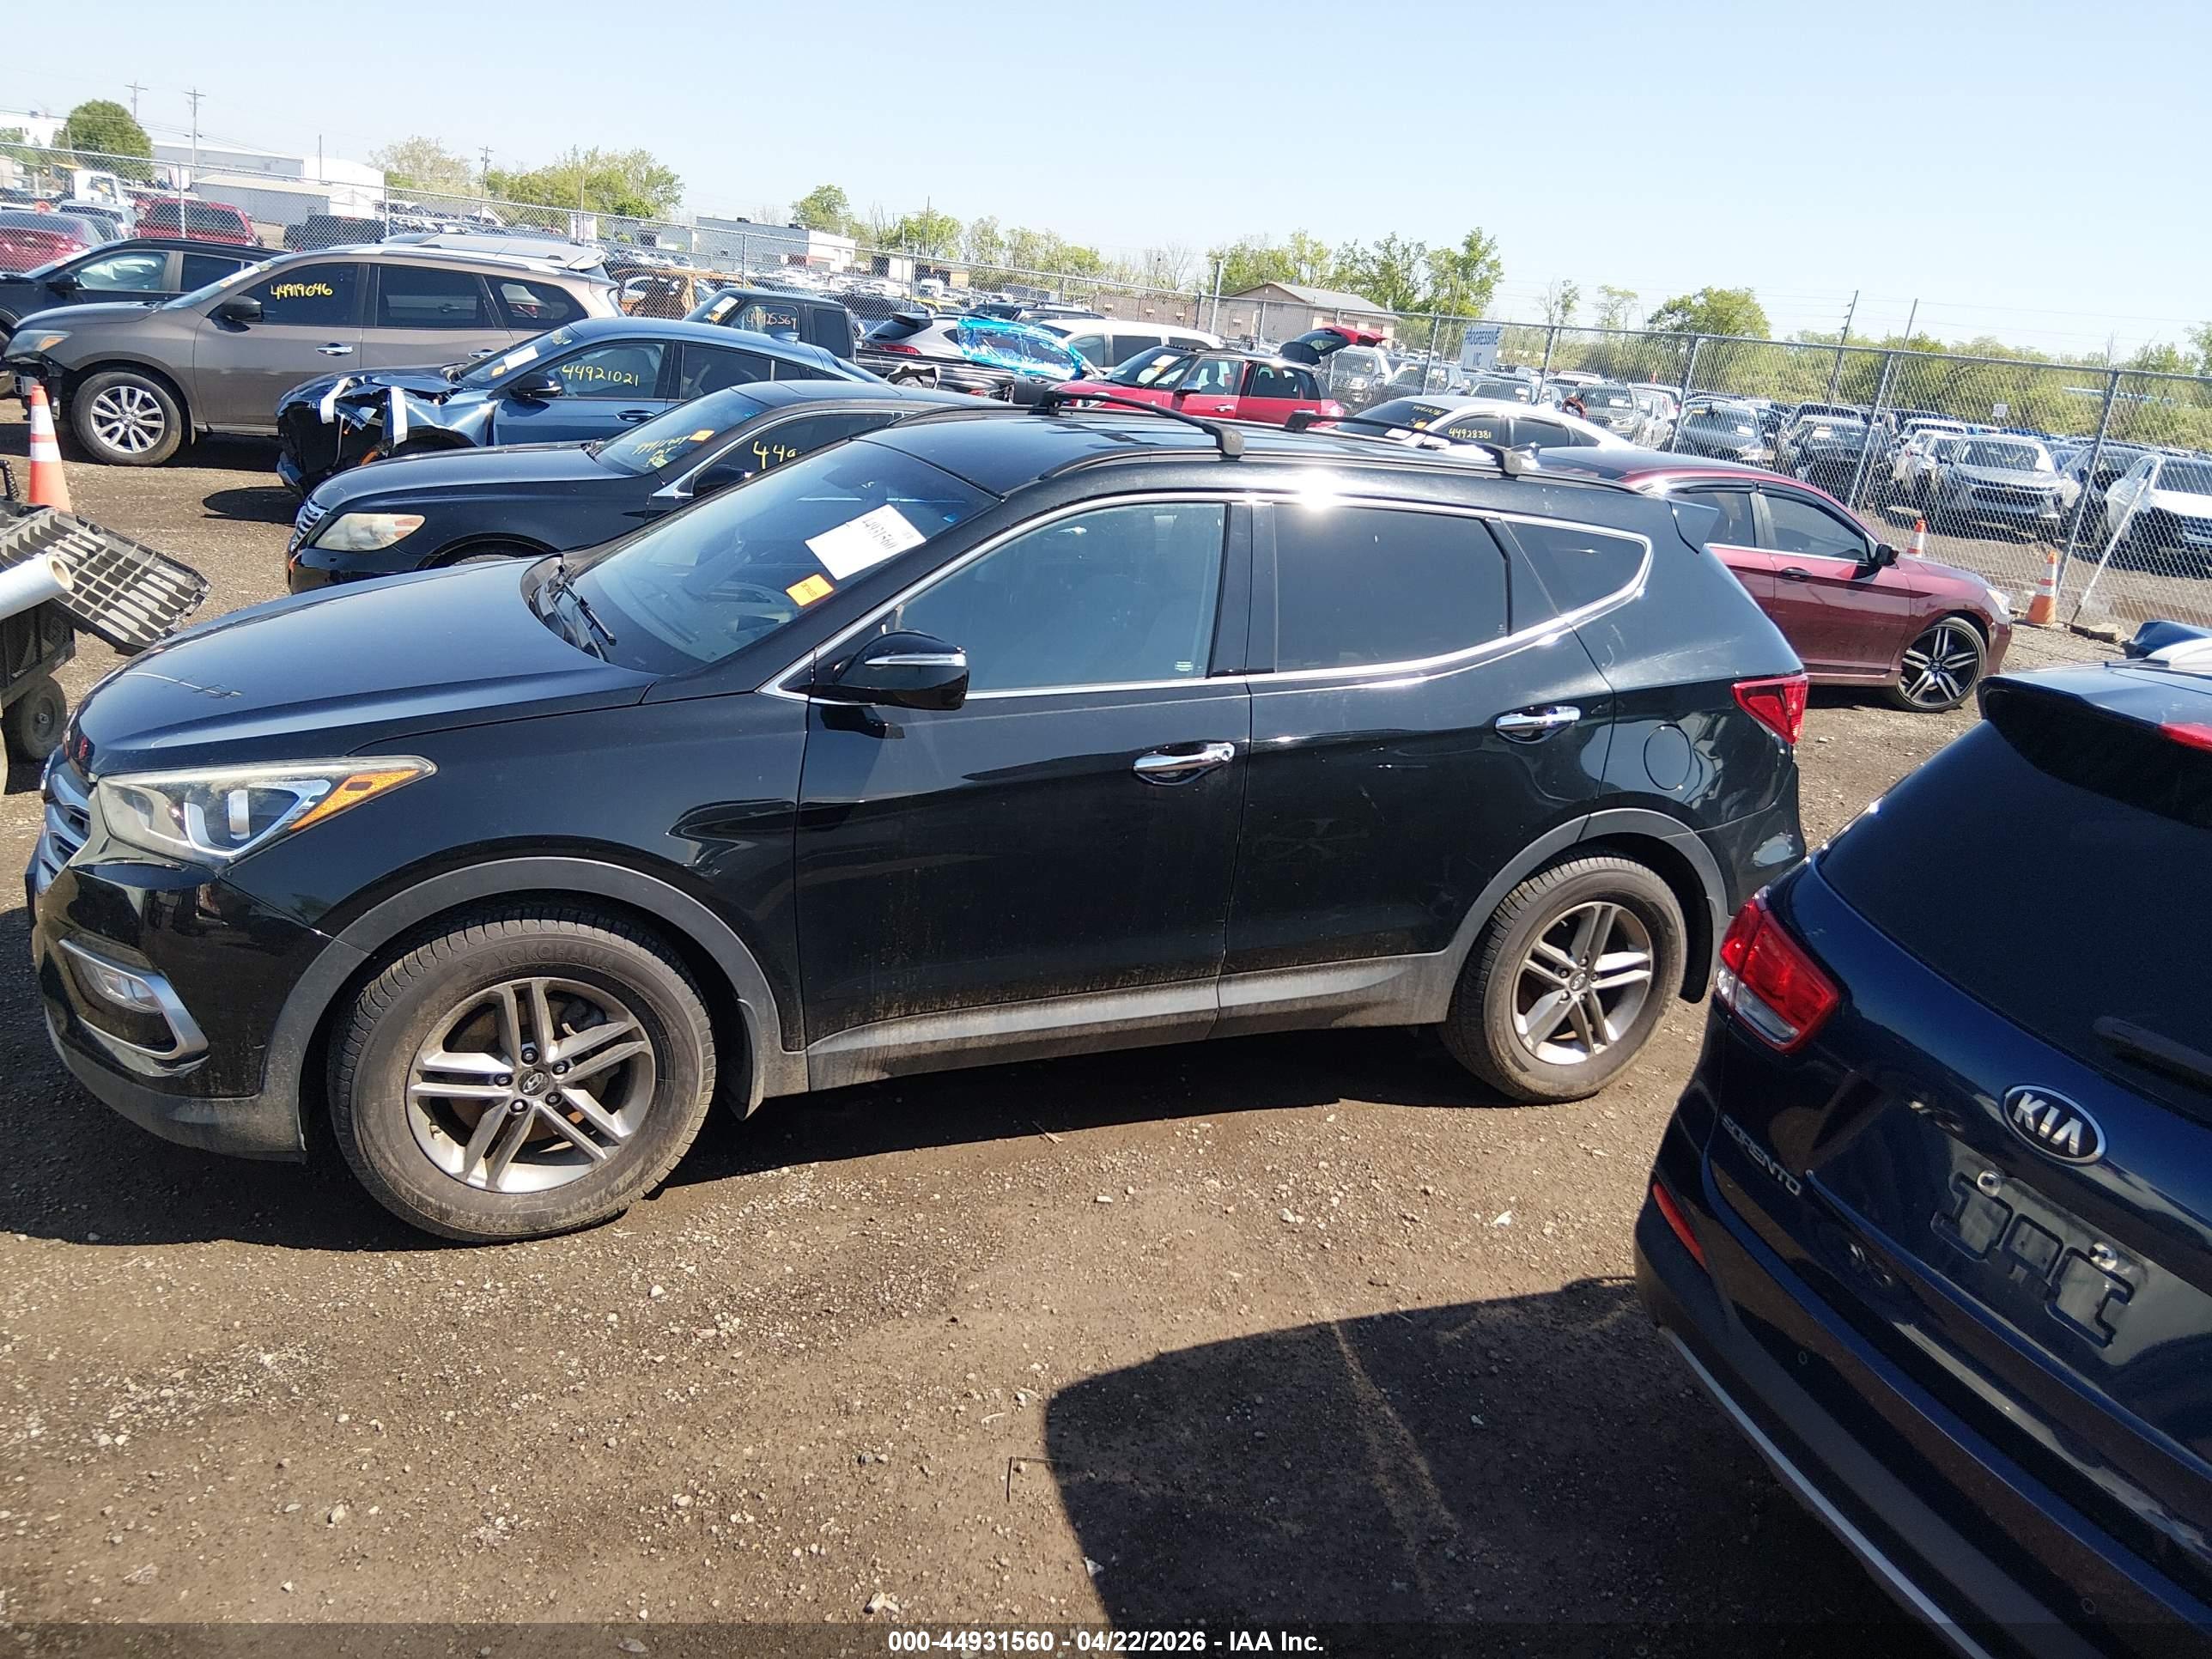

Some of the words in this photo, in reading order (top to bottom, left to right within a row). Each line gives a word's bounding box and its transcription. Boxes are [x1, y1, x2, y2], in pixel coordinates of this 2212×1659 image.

[1464, 331, 1500, 345] PROGRESSIVE
[562, 365, 639, 387] 44921021
[1448, 428, 1492, 439] 44928381
[493, 946, 616, 971] YOKOHAMA
[2013, 1091, 2083, 1156] KIA
[1721, 1114, 1802, 1196] SORENTO
